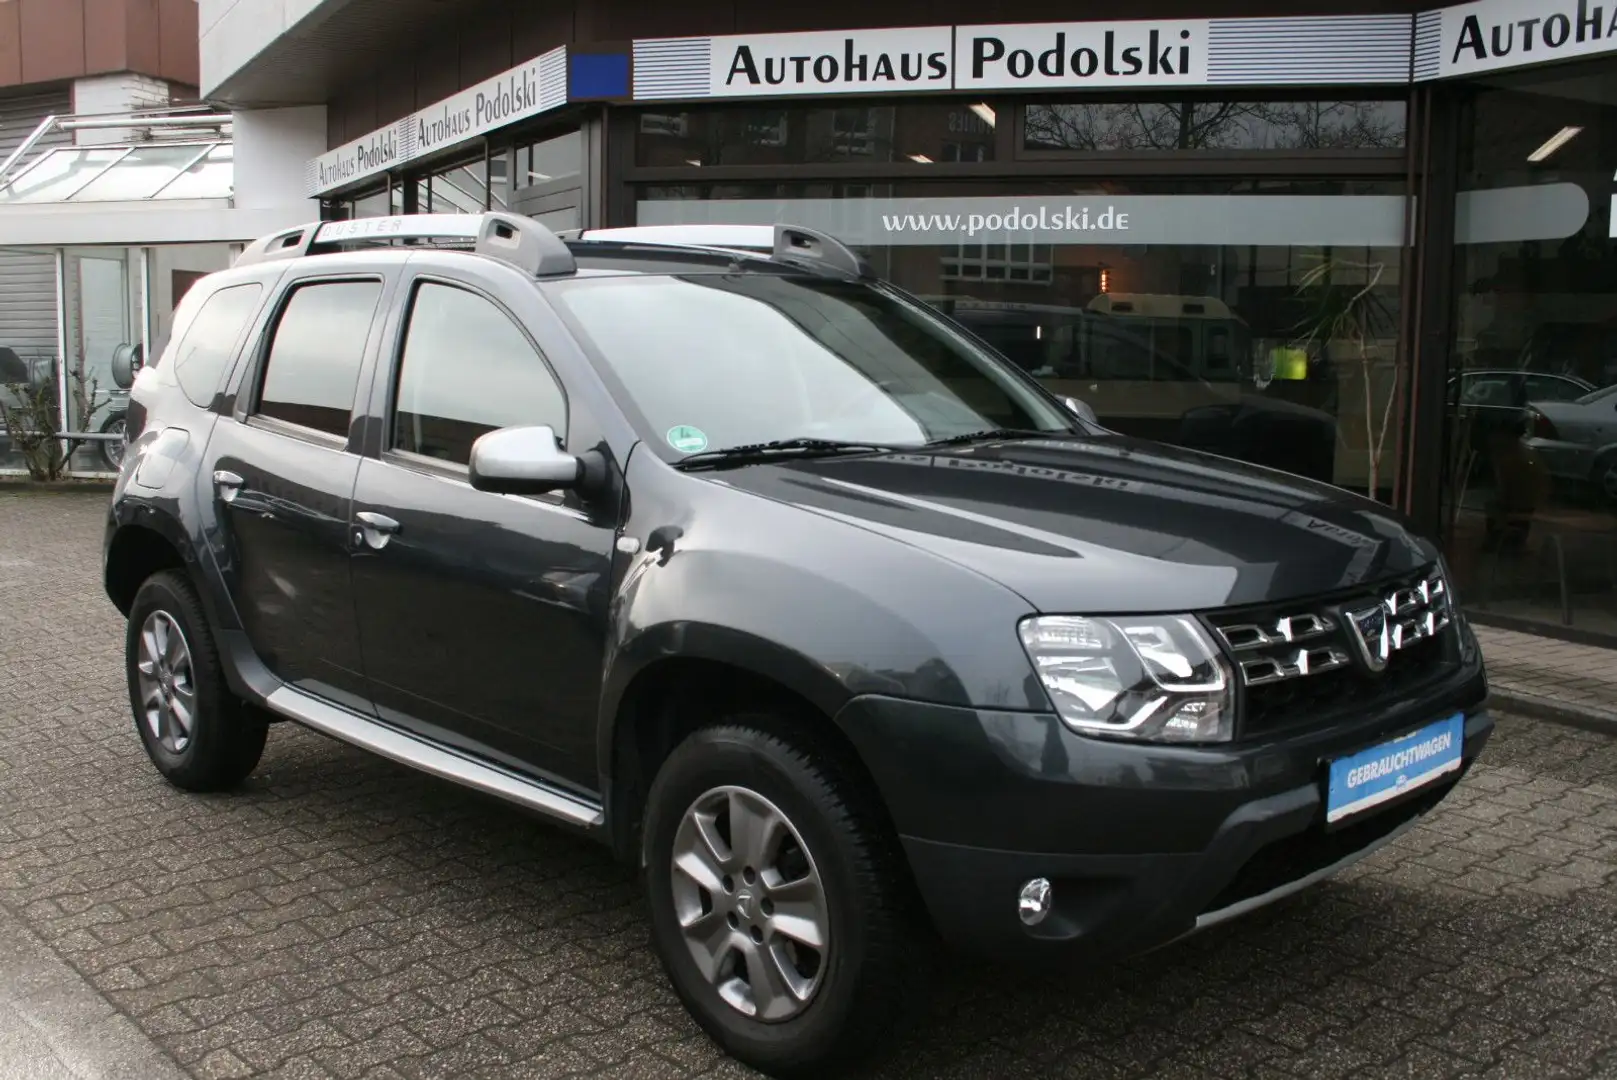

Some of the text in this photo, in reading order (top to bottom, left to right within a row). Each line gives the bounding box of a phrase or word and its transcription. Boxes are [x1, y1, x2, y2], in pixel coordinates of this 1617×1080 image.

[972, 29, 1190, 79] Podolski
[476, 67, 537, 127] Podolski
[357, 128, 397, 173] Podolski
[322, 219, 402, 237] DUSTER
[882, 205, 1129, 236] www.podolski.de
[1347, 731, 1452, 789] GEBRAUCHTWAGEN
